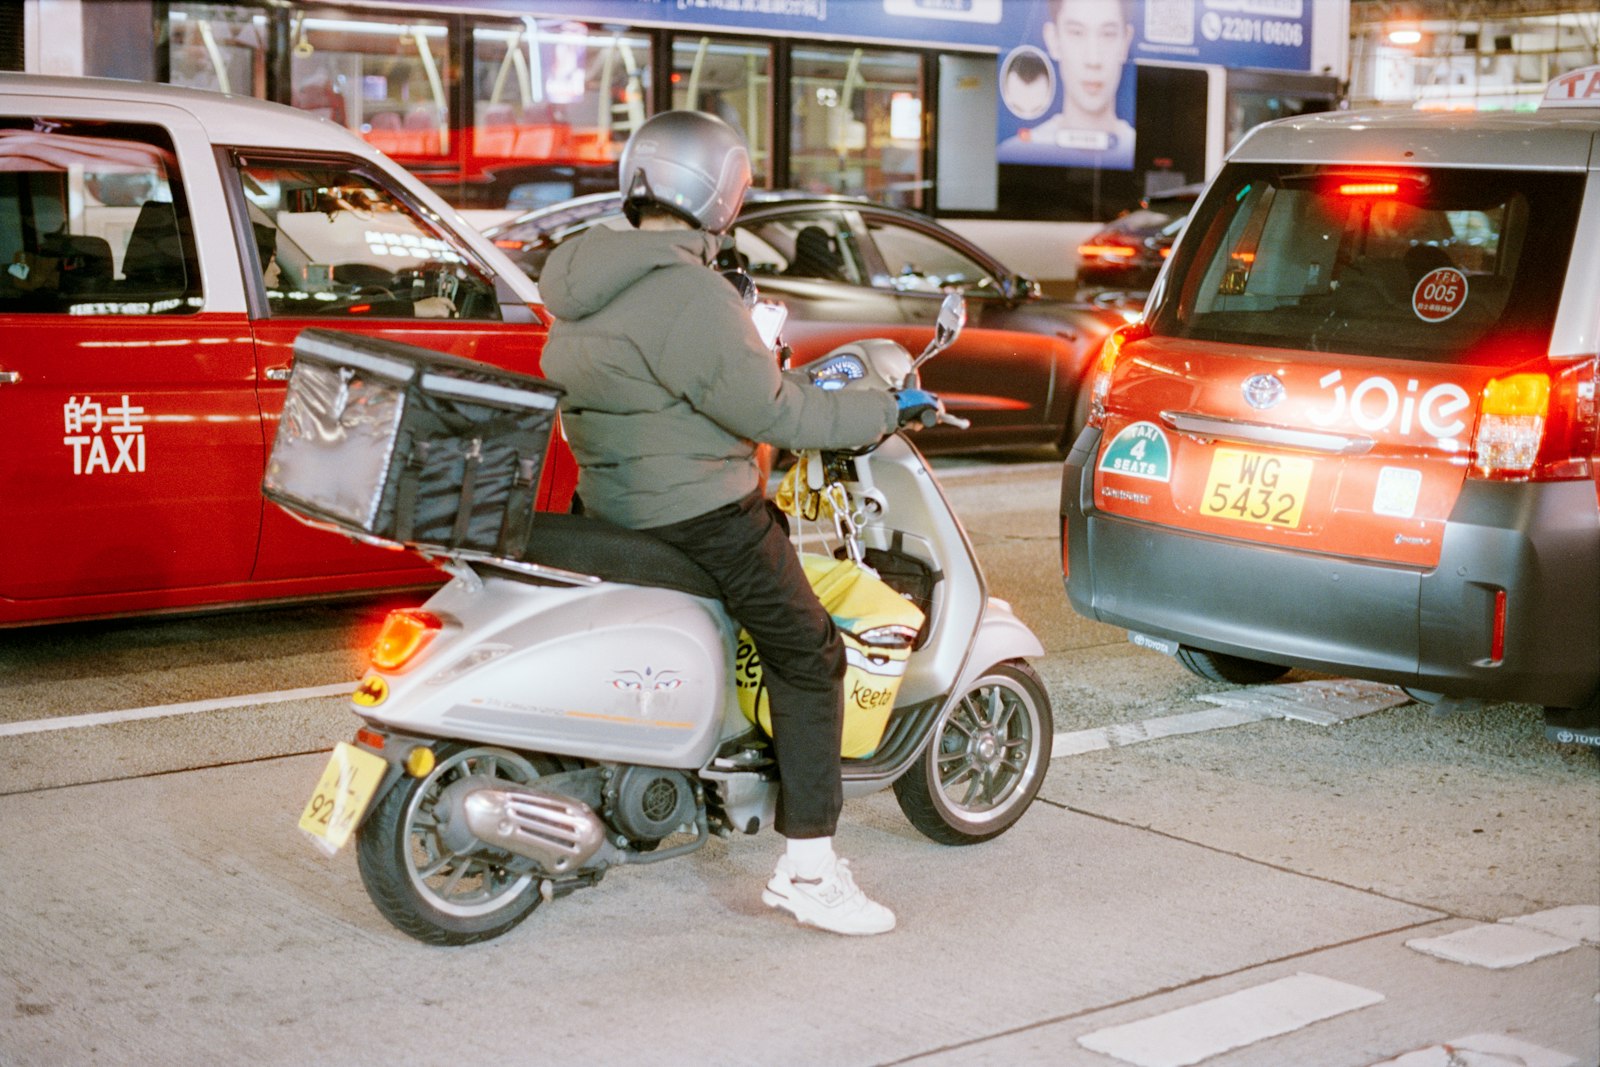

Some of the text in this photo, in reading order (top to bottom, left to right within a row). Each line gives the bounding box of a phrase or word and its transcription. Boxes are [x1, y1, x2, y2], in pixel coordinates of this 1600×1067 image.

[1423, 283, 1458, 302] 005
[63, 394, 145, 434] 的士
[1131, 425, 1160, 442] TAXI
[63, 433, 146, 475] TAXI
[1129, 439, 1147, 461] 4
[1113, 457, 1157, 475] SEATS
[1239, 454, 1282, 489] WG
[1209, 483, 1296, 525] 5432
